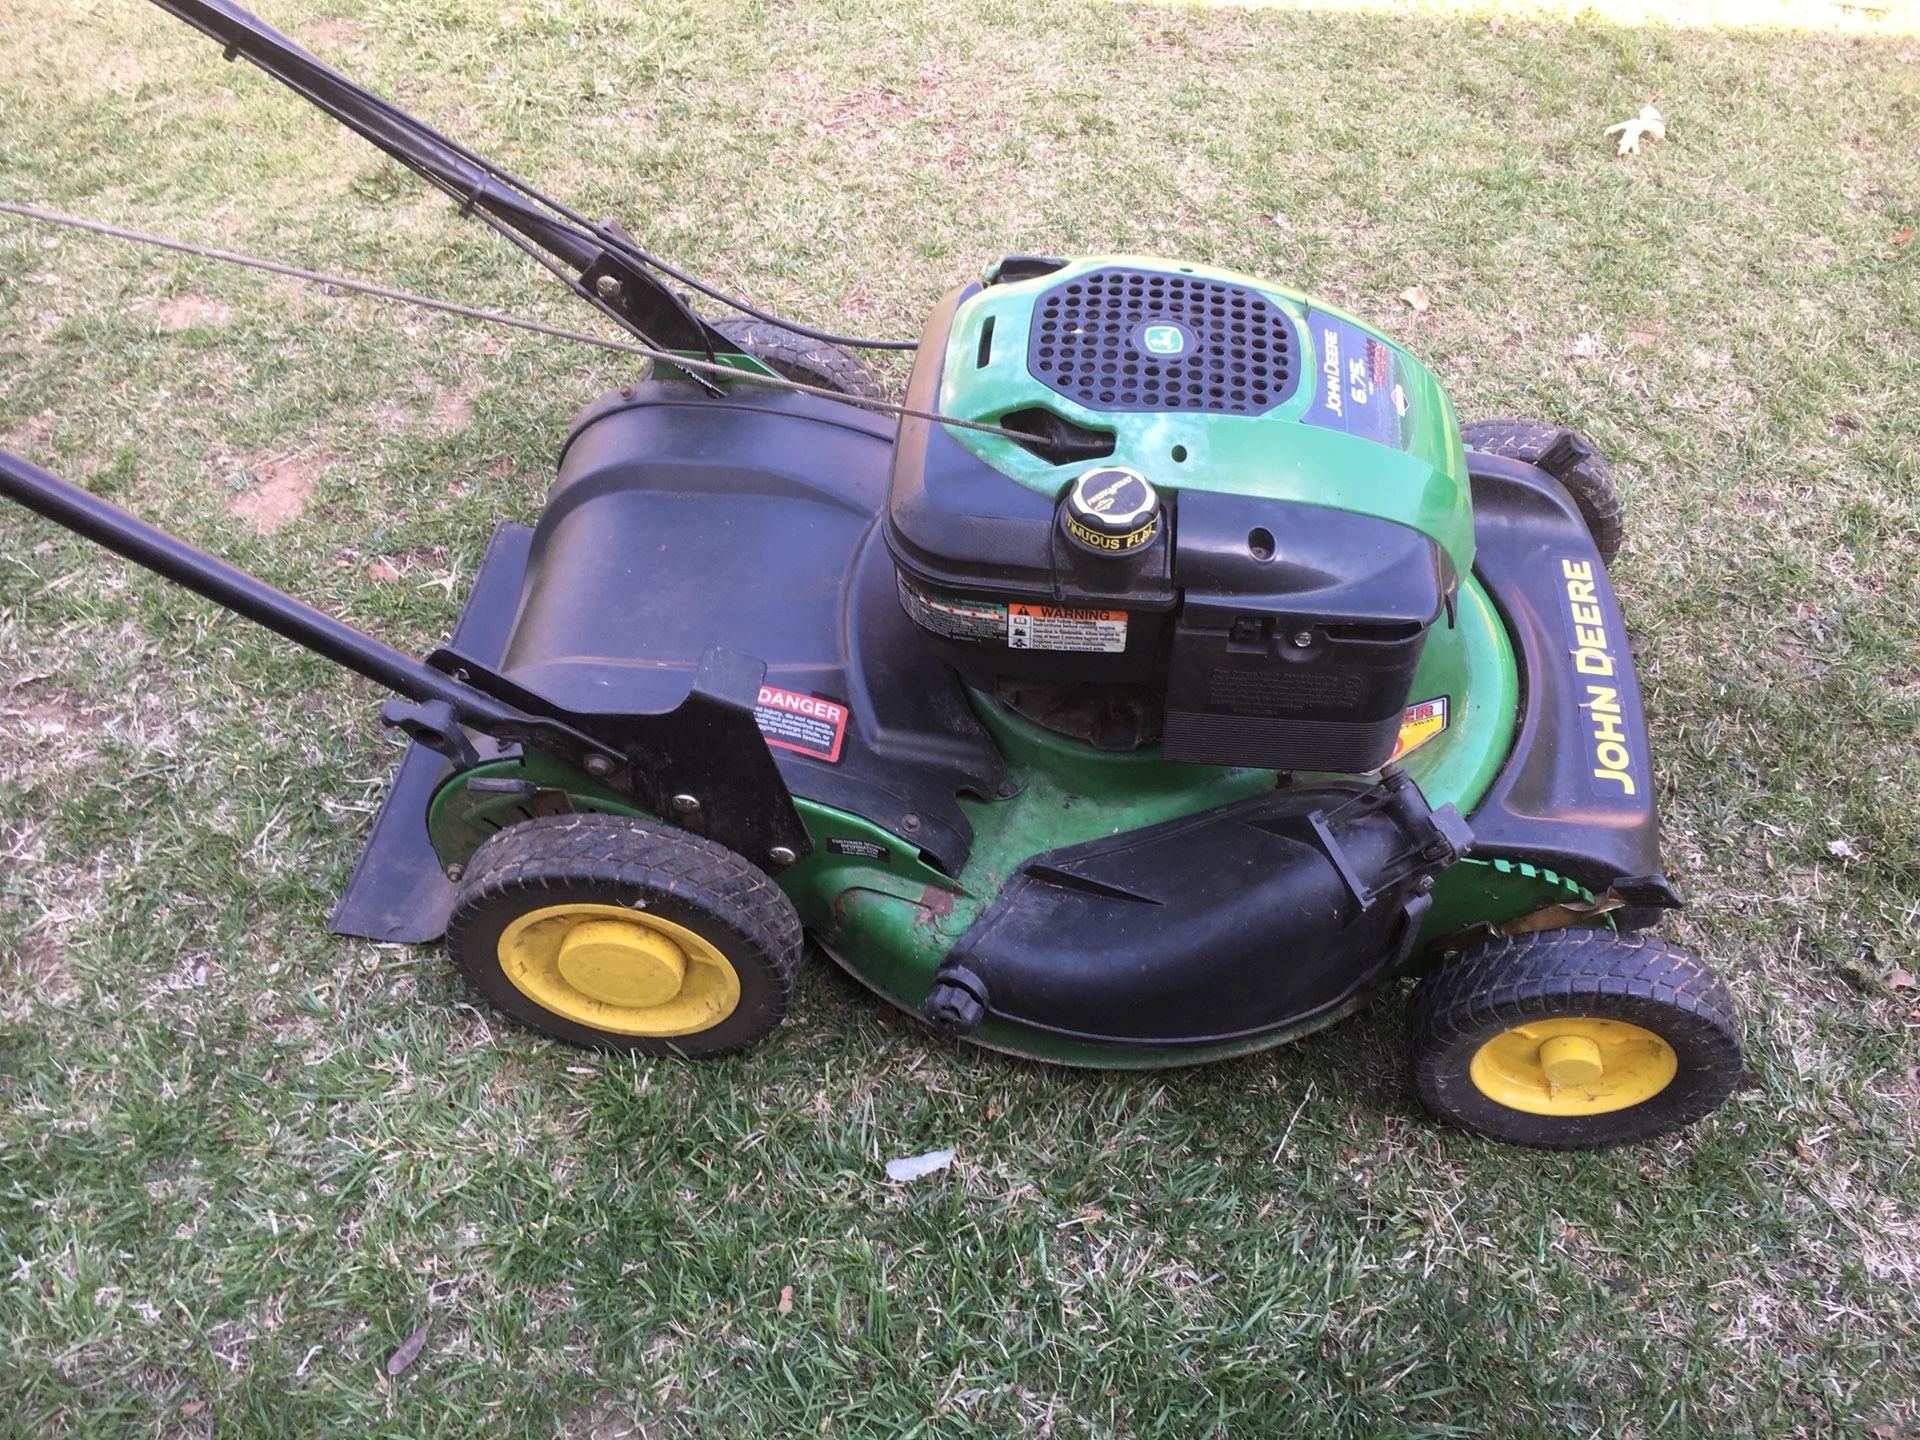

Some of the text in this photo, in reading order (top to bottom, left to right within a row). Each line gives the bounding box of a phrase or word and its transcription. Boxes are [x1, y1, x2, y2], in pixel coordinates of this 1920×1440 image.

[1324, 329, 1342, 417] JOHN DEERE
[1067, 518, 1120, 549] TINUOUS
[1041, 607, 1110, 621] WARNING
[1562, 559, 1635, 795] JOHN DEERE
[758, 688, 840, 722] DANGER
